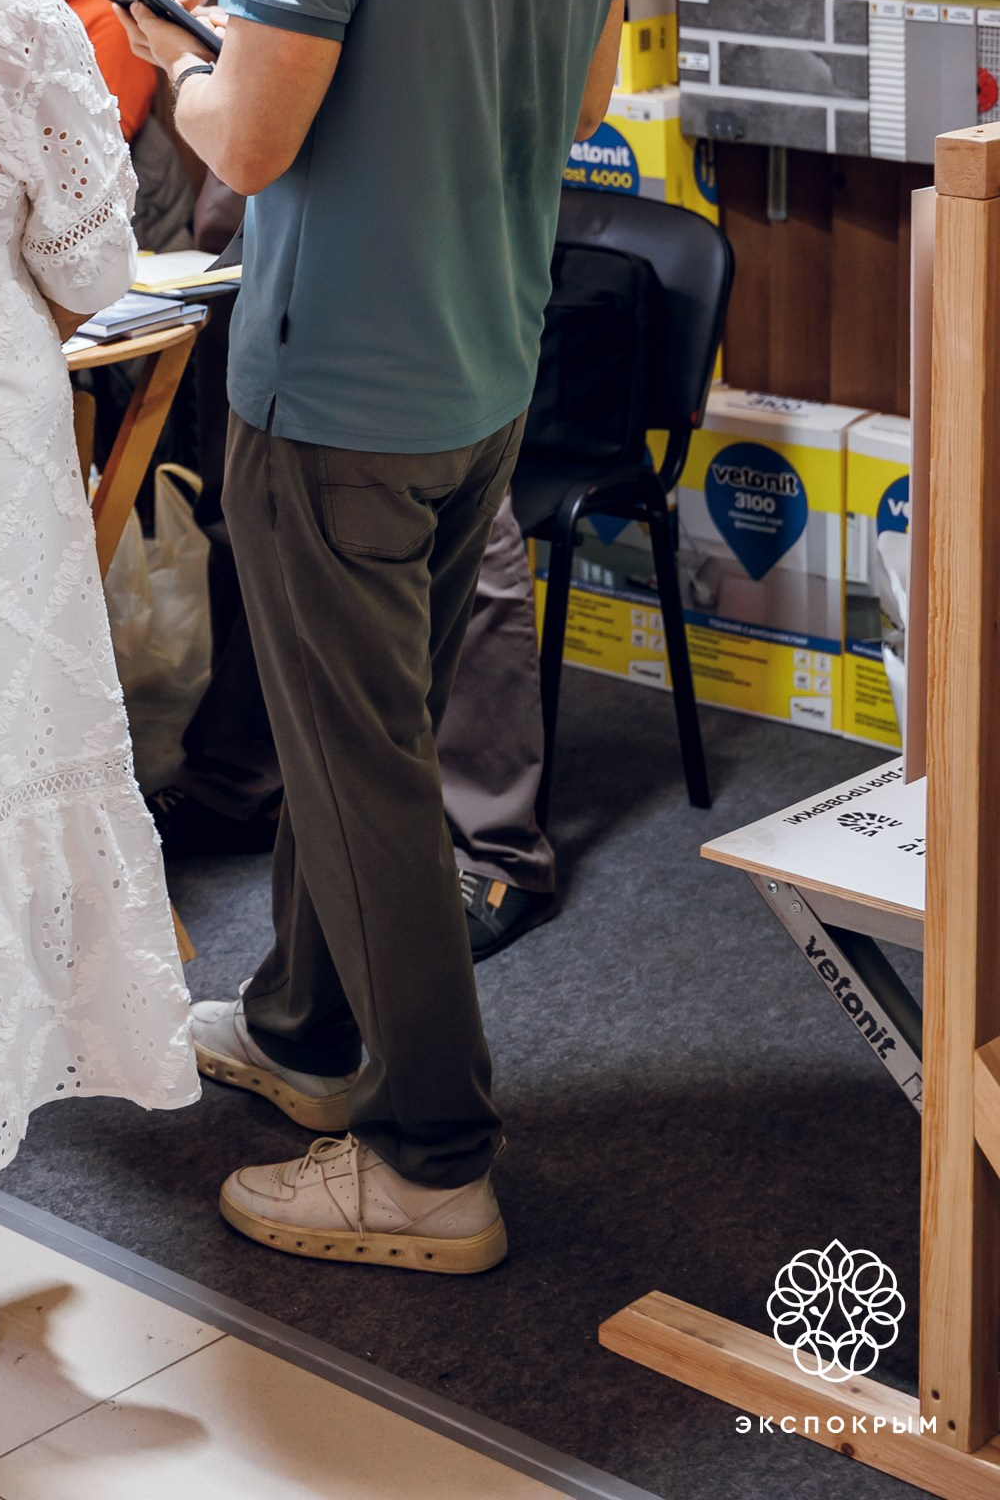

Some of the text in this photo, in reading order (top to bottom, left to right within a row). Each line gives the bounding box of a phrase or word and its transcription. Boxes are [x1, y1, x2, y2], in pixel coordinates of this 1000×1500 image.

[569, 141, 632, 168] etonit
[562, 168, 633, 190] ast 4000
[711, 462, 800, 496] vetonit
[734, 491, 776, 514] 3100
[782, 770, 901, 825] ДЛЯ ПРОВЕРКИ!
[805, 934, 896, 1060] vetonit
